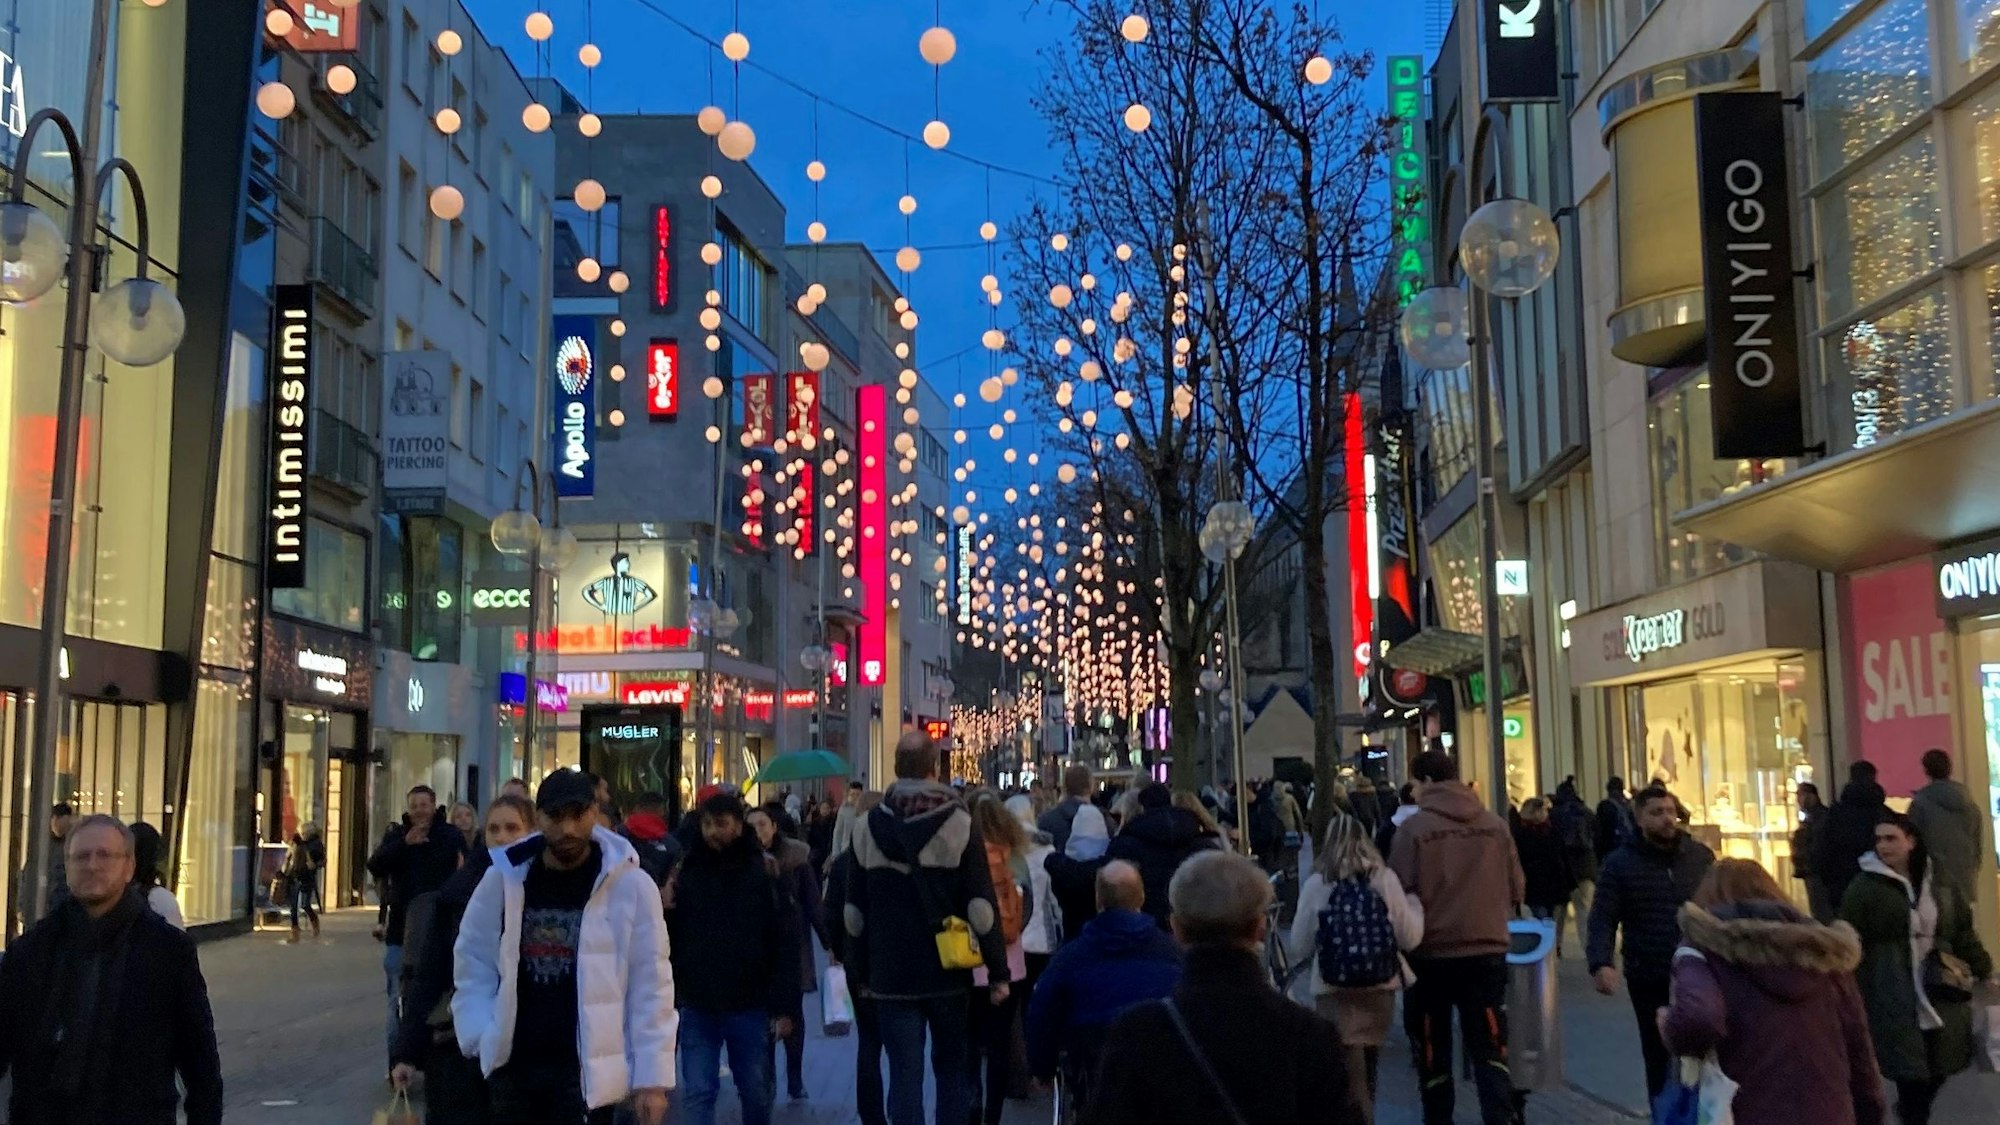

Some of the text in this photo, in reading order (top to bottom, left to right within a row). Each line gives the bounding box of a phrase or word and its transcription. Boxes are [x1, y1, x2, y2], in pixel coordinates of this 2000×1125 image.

[272, 309, 307, 562] intimissimi
[388, 436, 446, 453] TATTOO
[561, 401, 586, 479] Apollo
[387, 455, 445, 471] PIERCING
[1862, 631, 1951, 723] SALE
[601, 725, 659, 739] MUGLER
